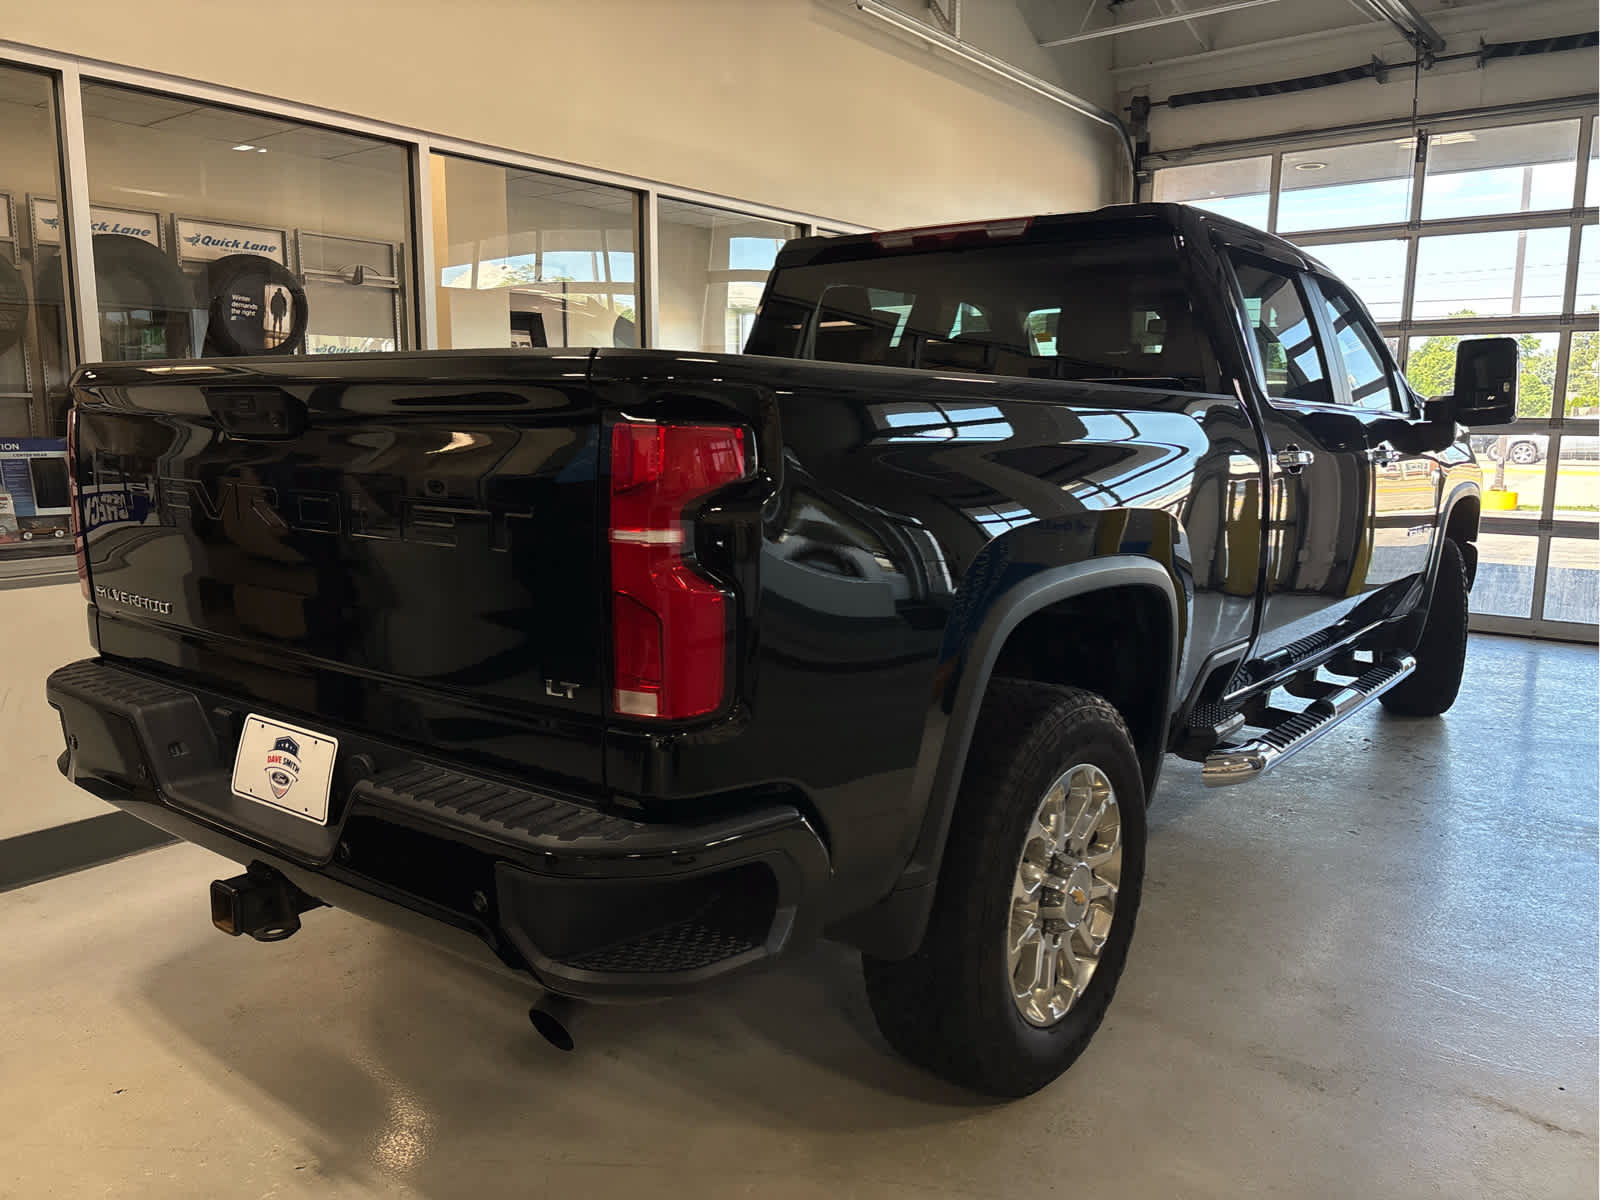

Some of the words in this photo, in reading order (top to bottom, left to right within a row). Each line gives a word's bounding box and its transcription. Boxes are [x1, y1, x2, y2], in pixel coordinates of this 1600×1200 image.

[111, 223, 152, 236] Lane
[201, 235, 241, 249] Quick
[243, 240, 277, 253] Lane
[95, 584, 173, 614] SILVERADO
[545, 680, 581, 700] LT
[267, 755, 282, 764] DAVE
[283, 757, 299, 773] SMITH
